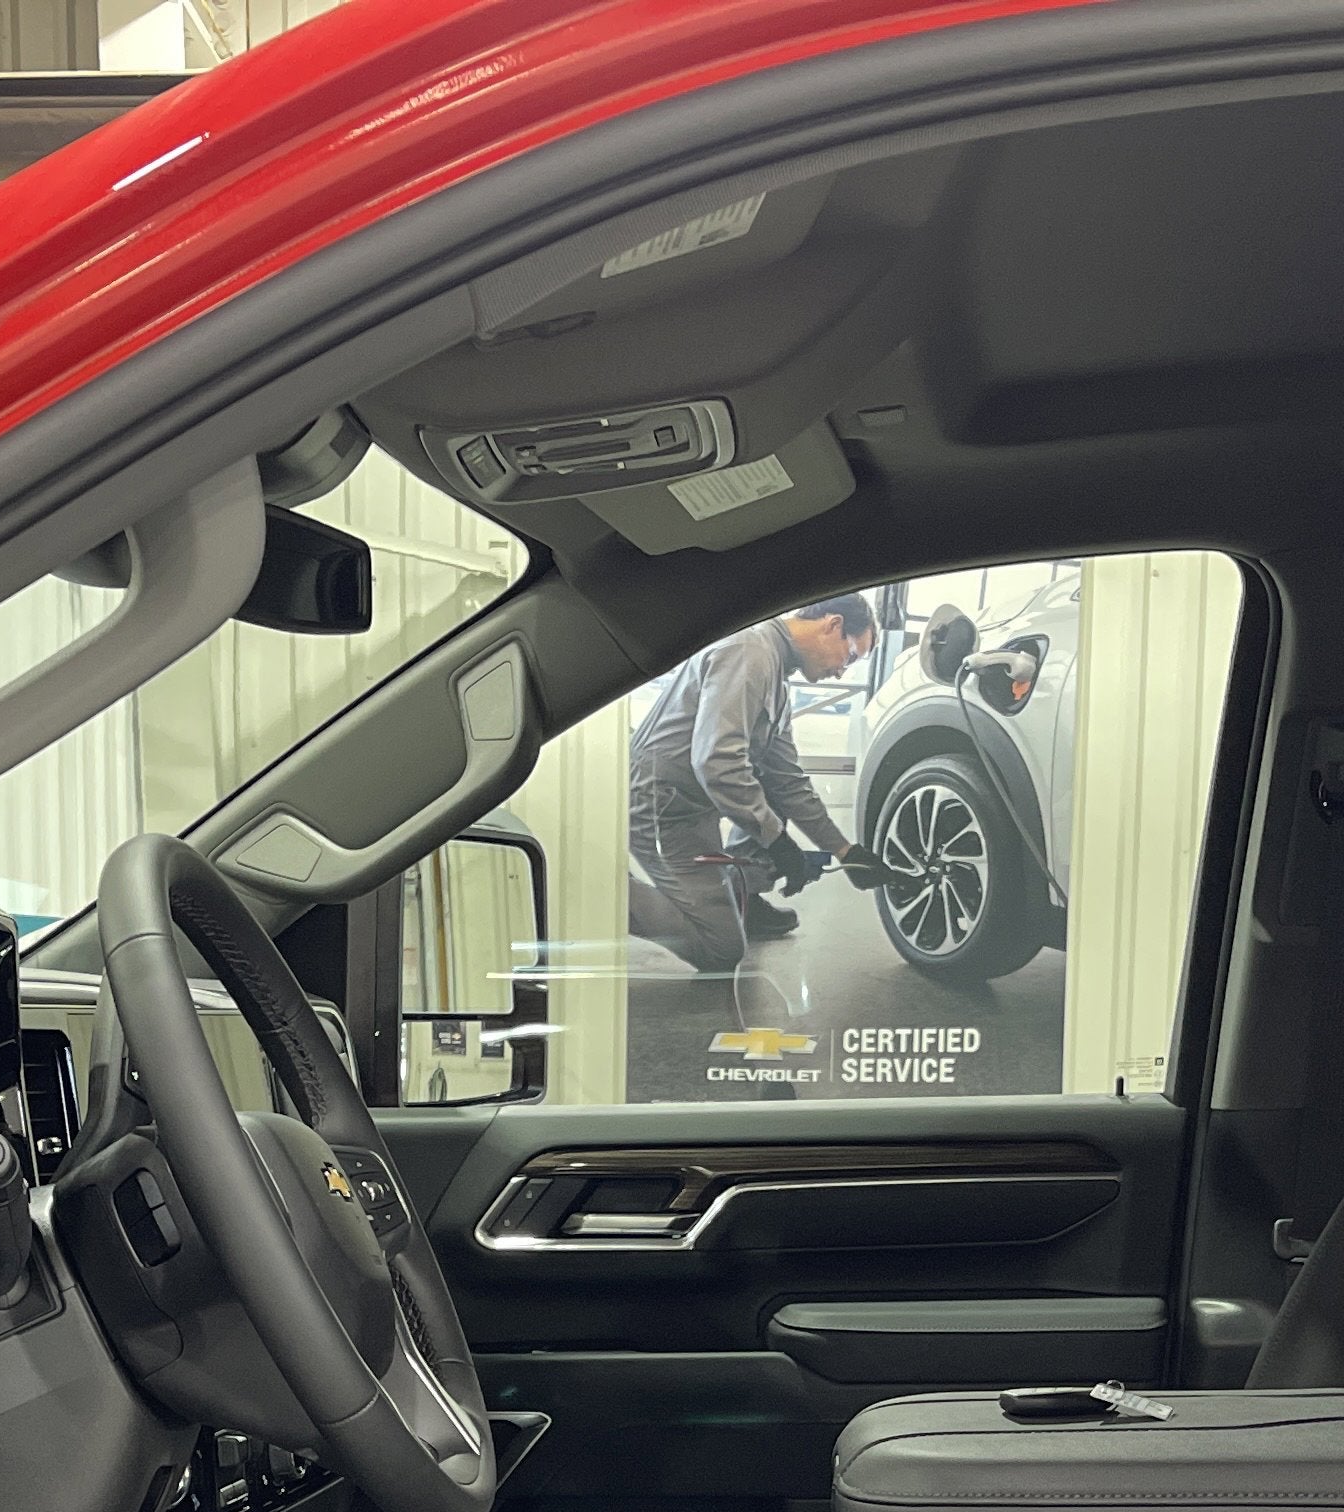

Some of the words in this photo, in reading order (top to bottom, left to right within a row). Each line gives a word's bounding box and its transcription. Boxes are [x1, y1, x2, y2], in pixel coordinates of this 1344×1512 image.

[842, 1028, 981, 1053] CERTIFIED
[706, 1067, 822, 1083] CHEVROLET
[841, 1058, 956, 1083] SERVICE
